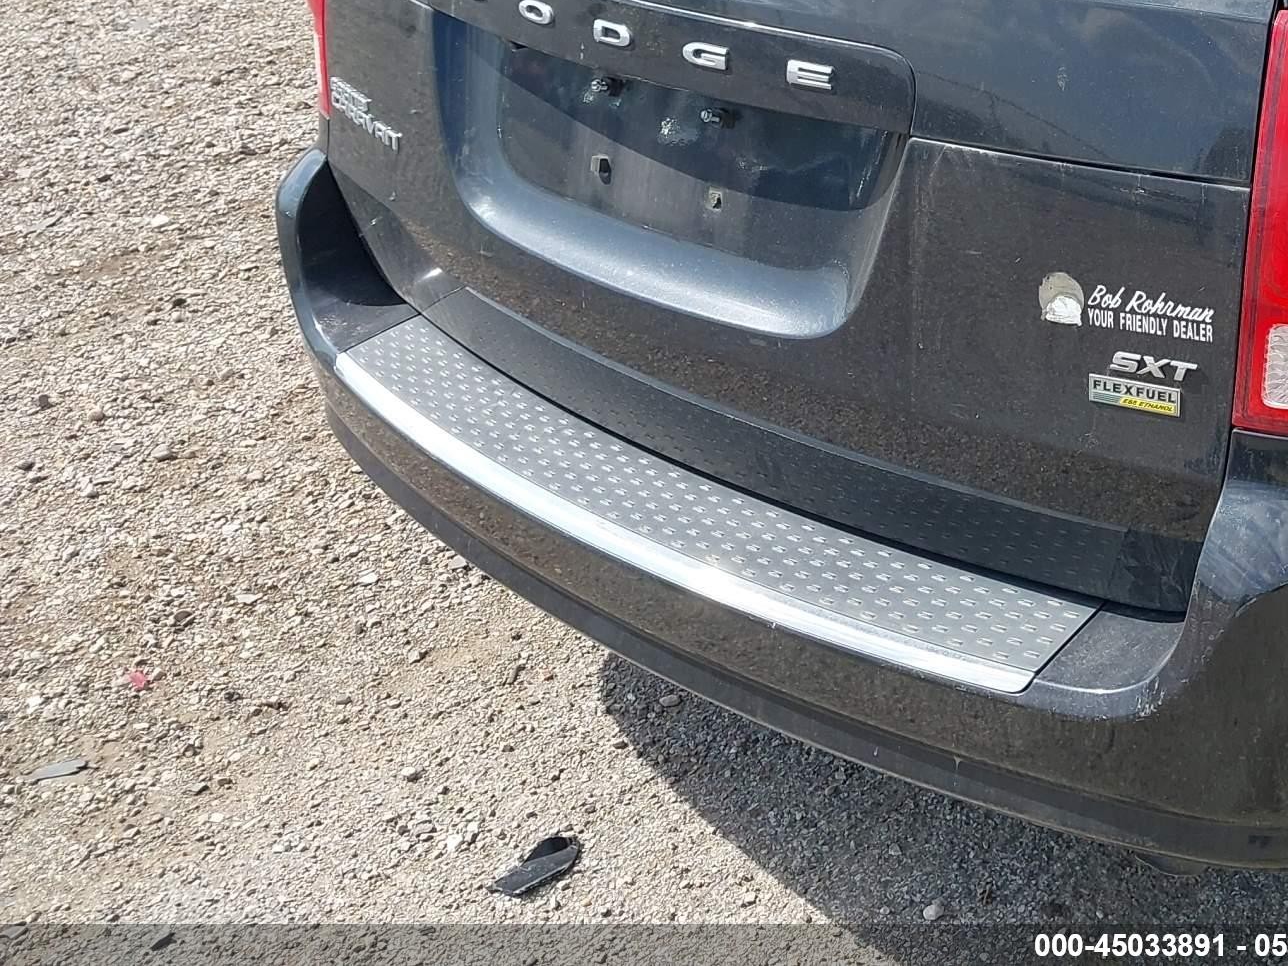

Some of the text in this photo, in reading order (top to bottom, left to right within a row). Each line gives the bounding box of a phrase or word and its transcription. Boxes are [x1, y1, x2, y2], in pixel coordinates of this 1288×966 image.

[1088, 284, 1215, 323] Bob Rohrman
[1088, 308, 1213, 343] YOUR FRIENDLY DEALER
[1110, 351, 1198, 381] SXT
[1093, 379, 1177, 404] FLEXFUEL
